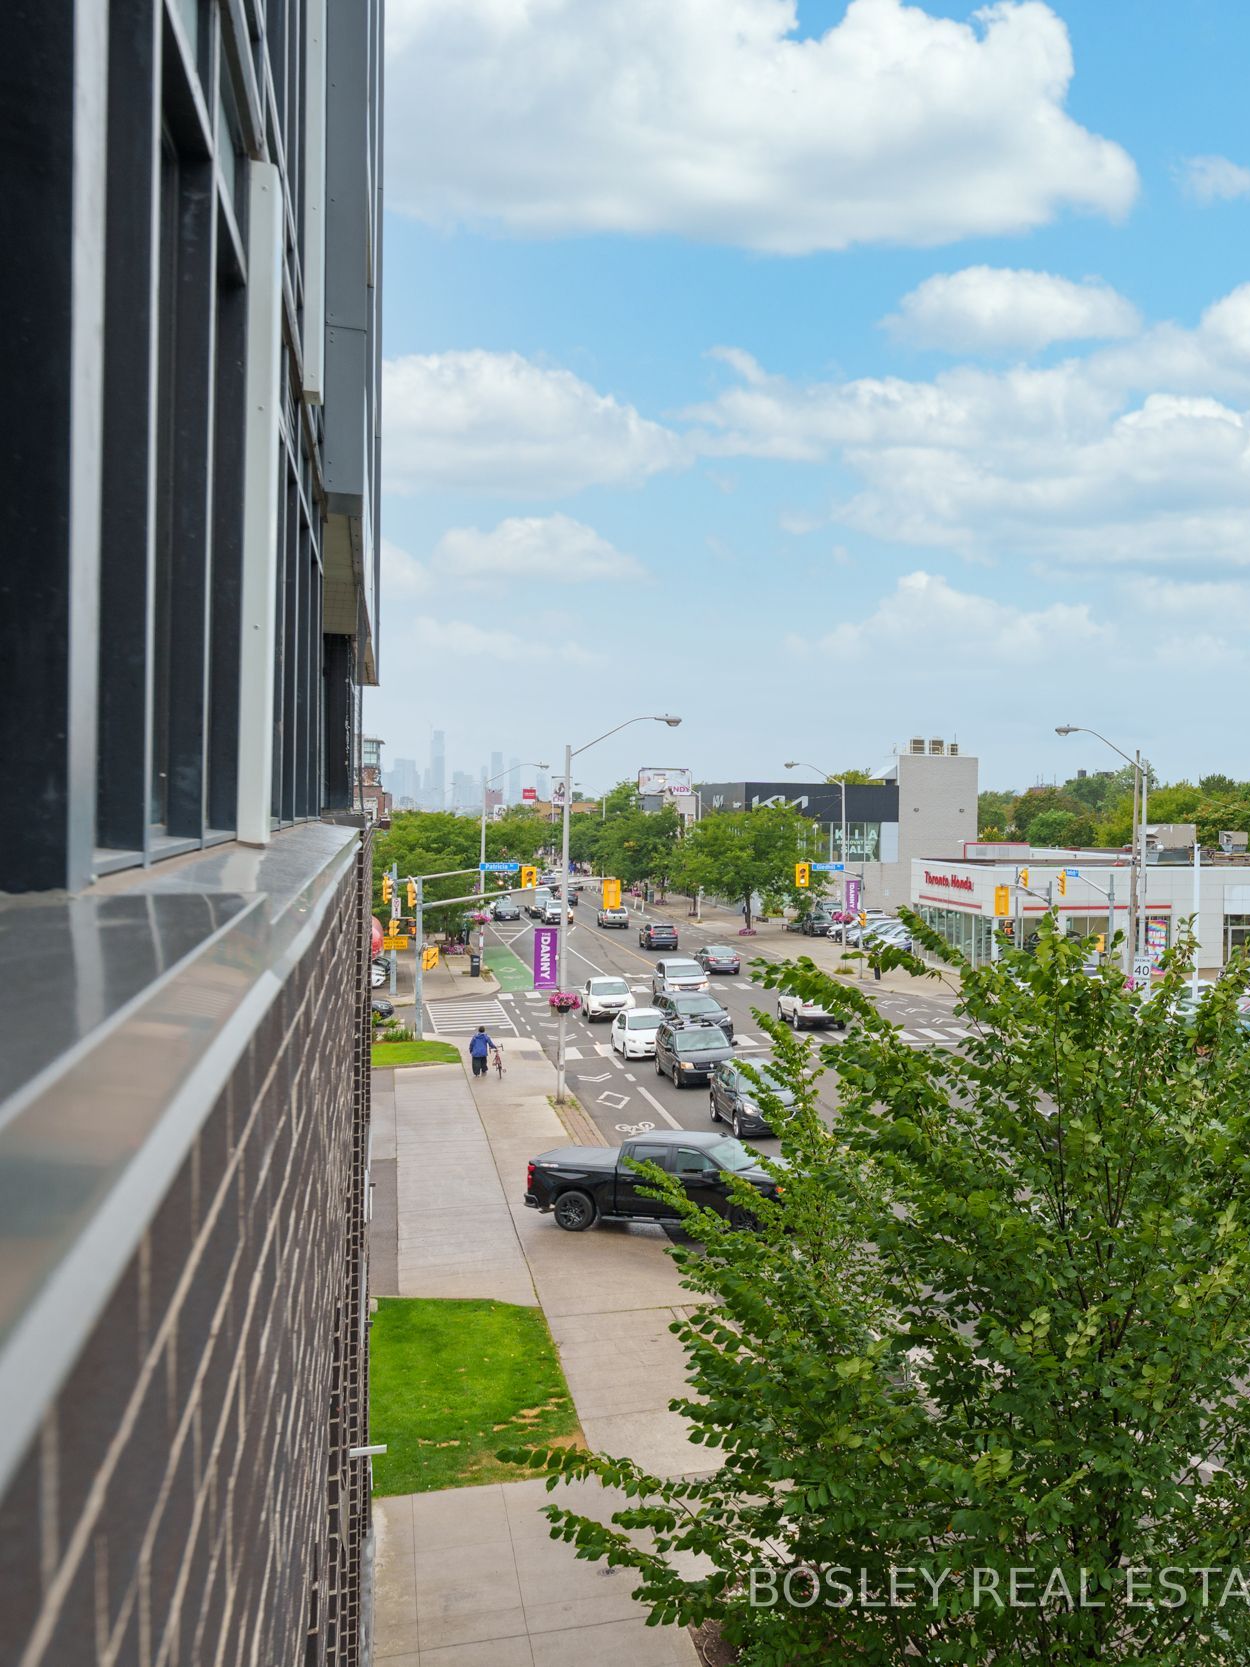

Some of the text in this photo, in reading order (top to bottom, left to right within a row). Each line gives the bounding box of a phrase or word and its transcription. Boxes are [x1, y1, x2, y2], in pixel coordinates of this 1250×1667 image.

[924, 870, 974, 891] Toronto Honda
[540, 937, 551, 980] DANNY
[1134, 965, 1150, 976] 40
